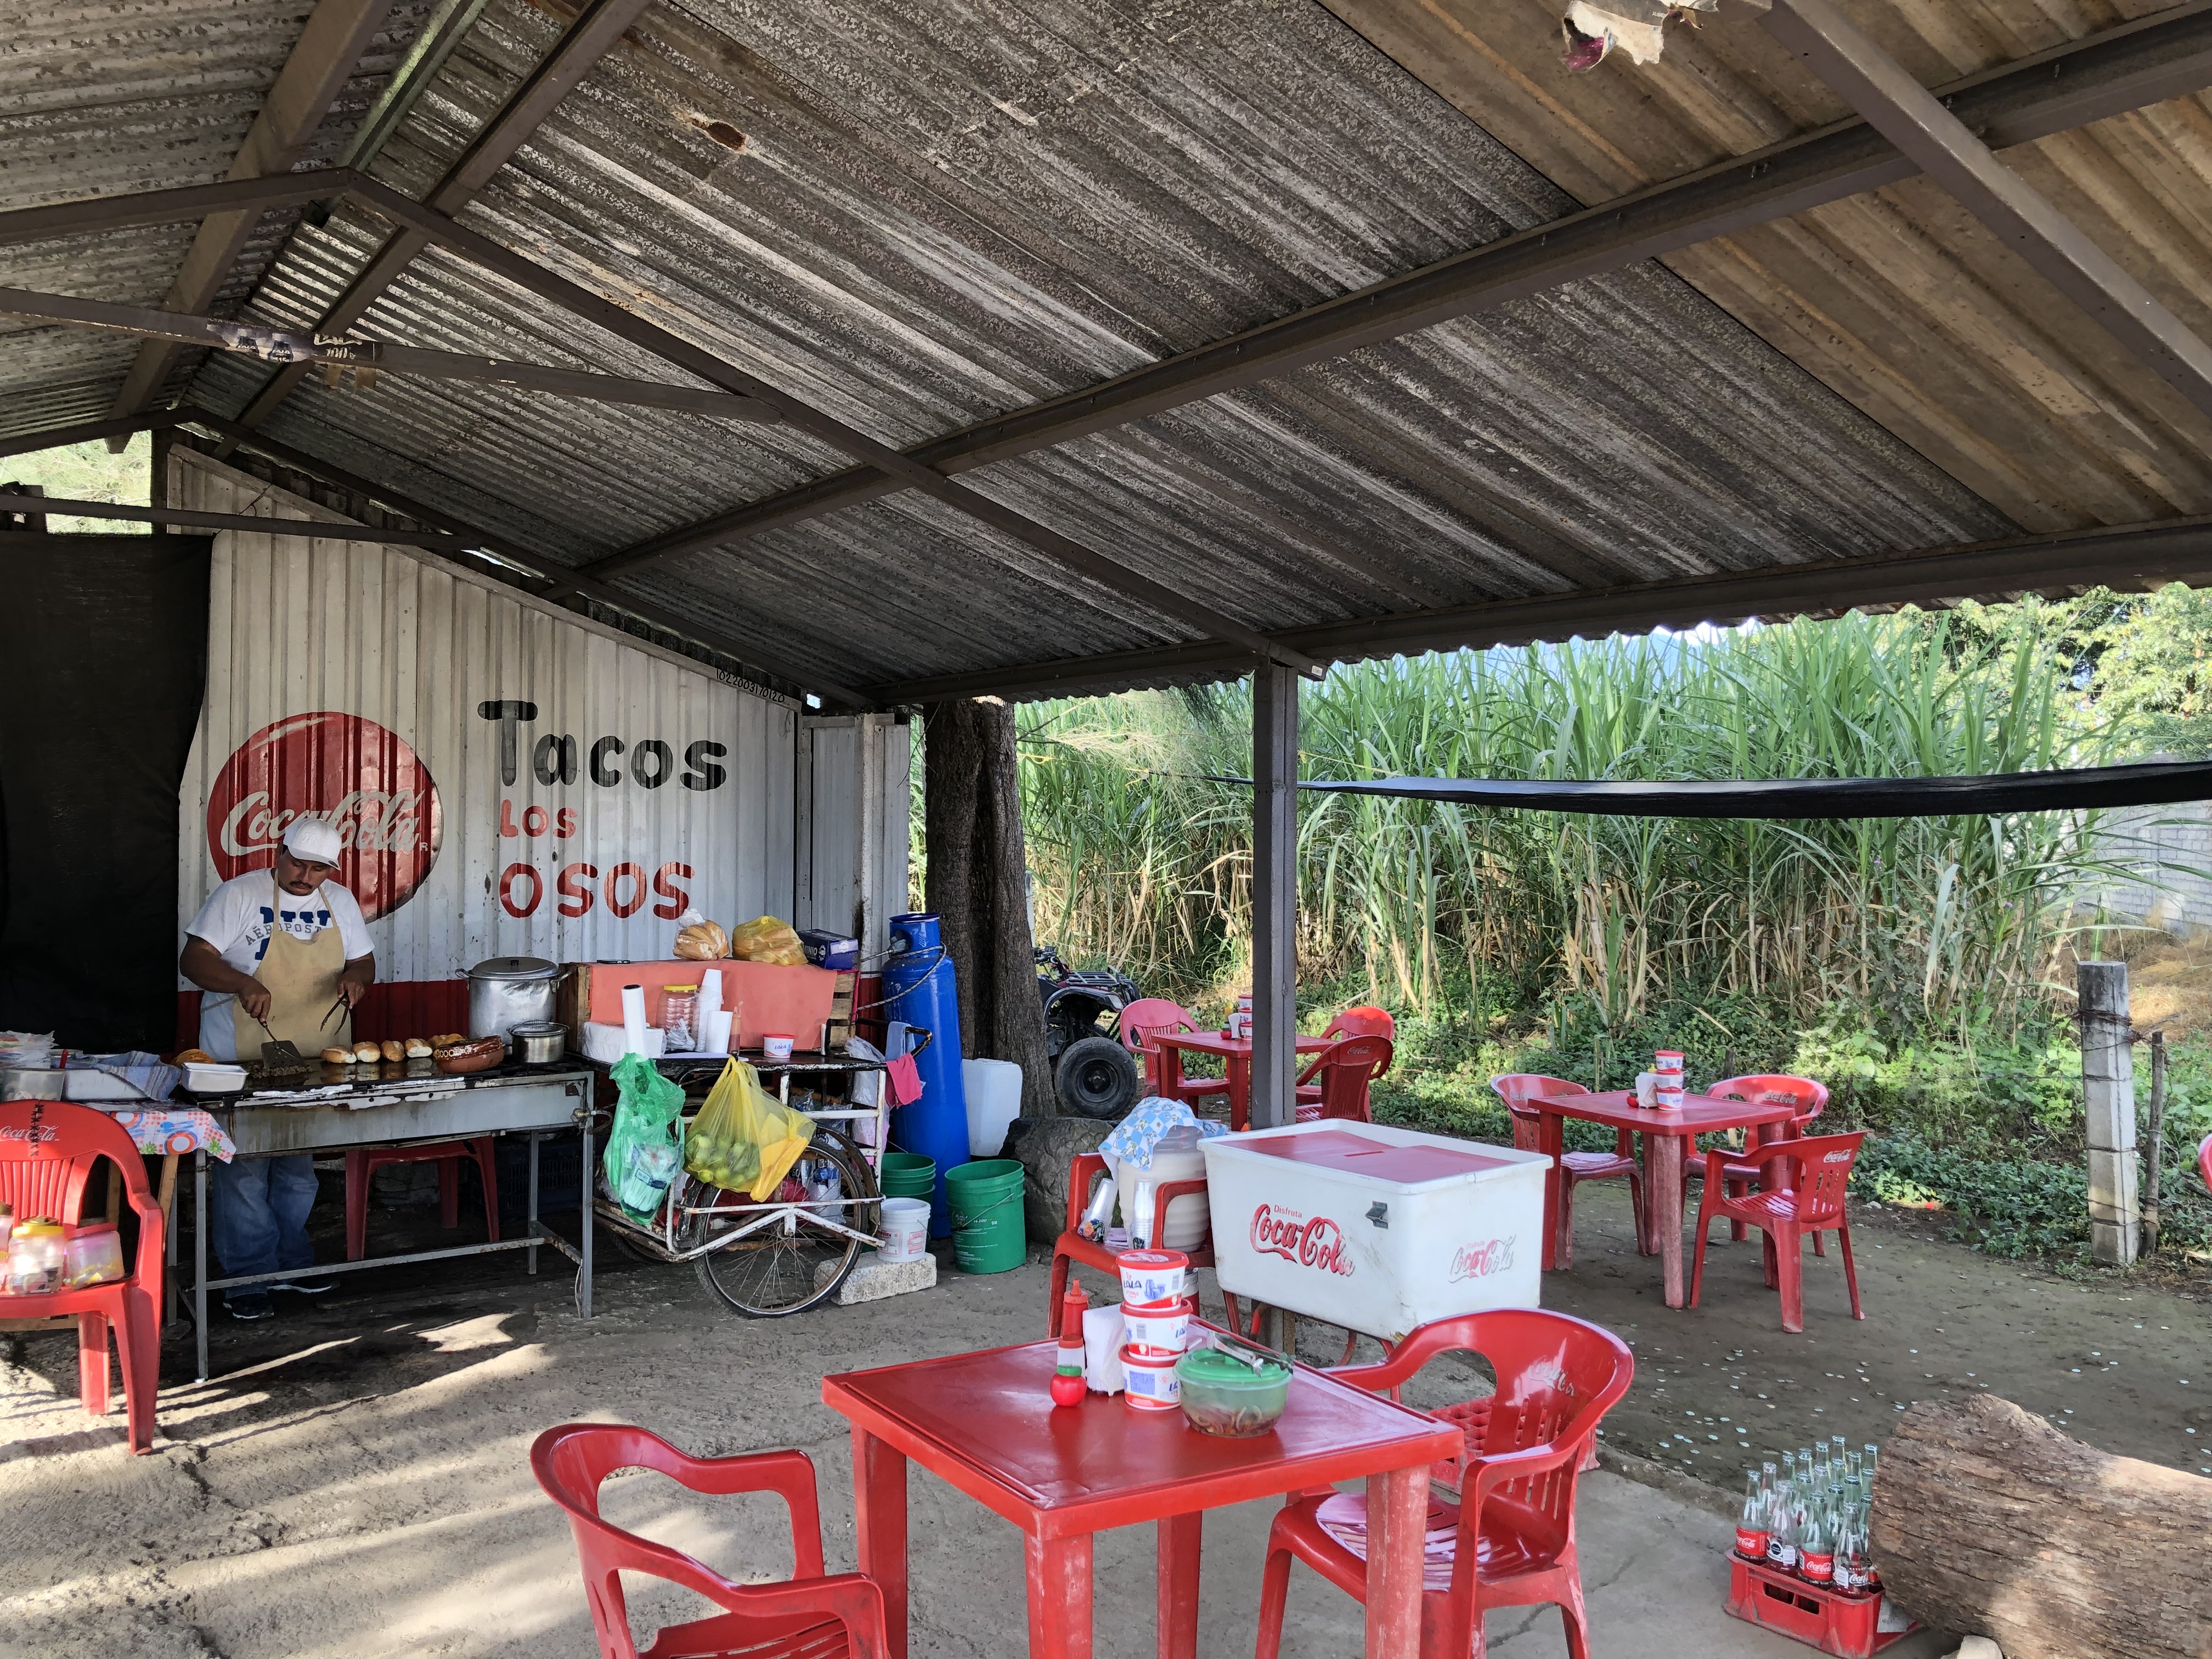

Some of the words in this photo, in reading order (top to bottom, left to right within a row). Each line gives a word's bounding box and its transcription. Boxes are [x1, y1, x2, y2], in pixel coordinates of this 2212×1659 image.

[477, 699, 727, 792] Tacos
[499, 861, 695, 920] OSOS
[1274, 1204, 1302, 1219] Disfruta
